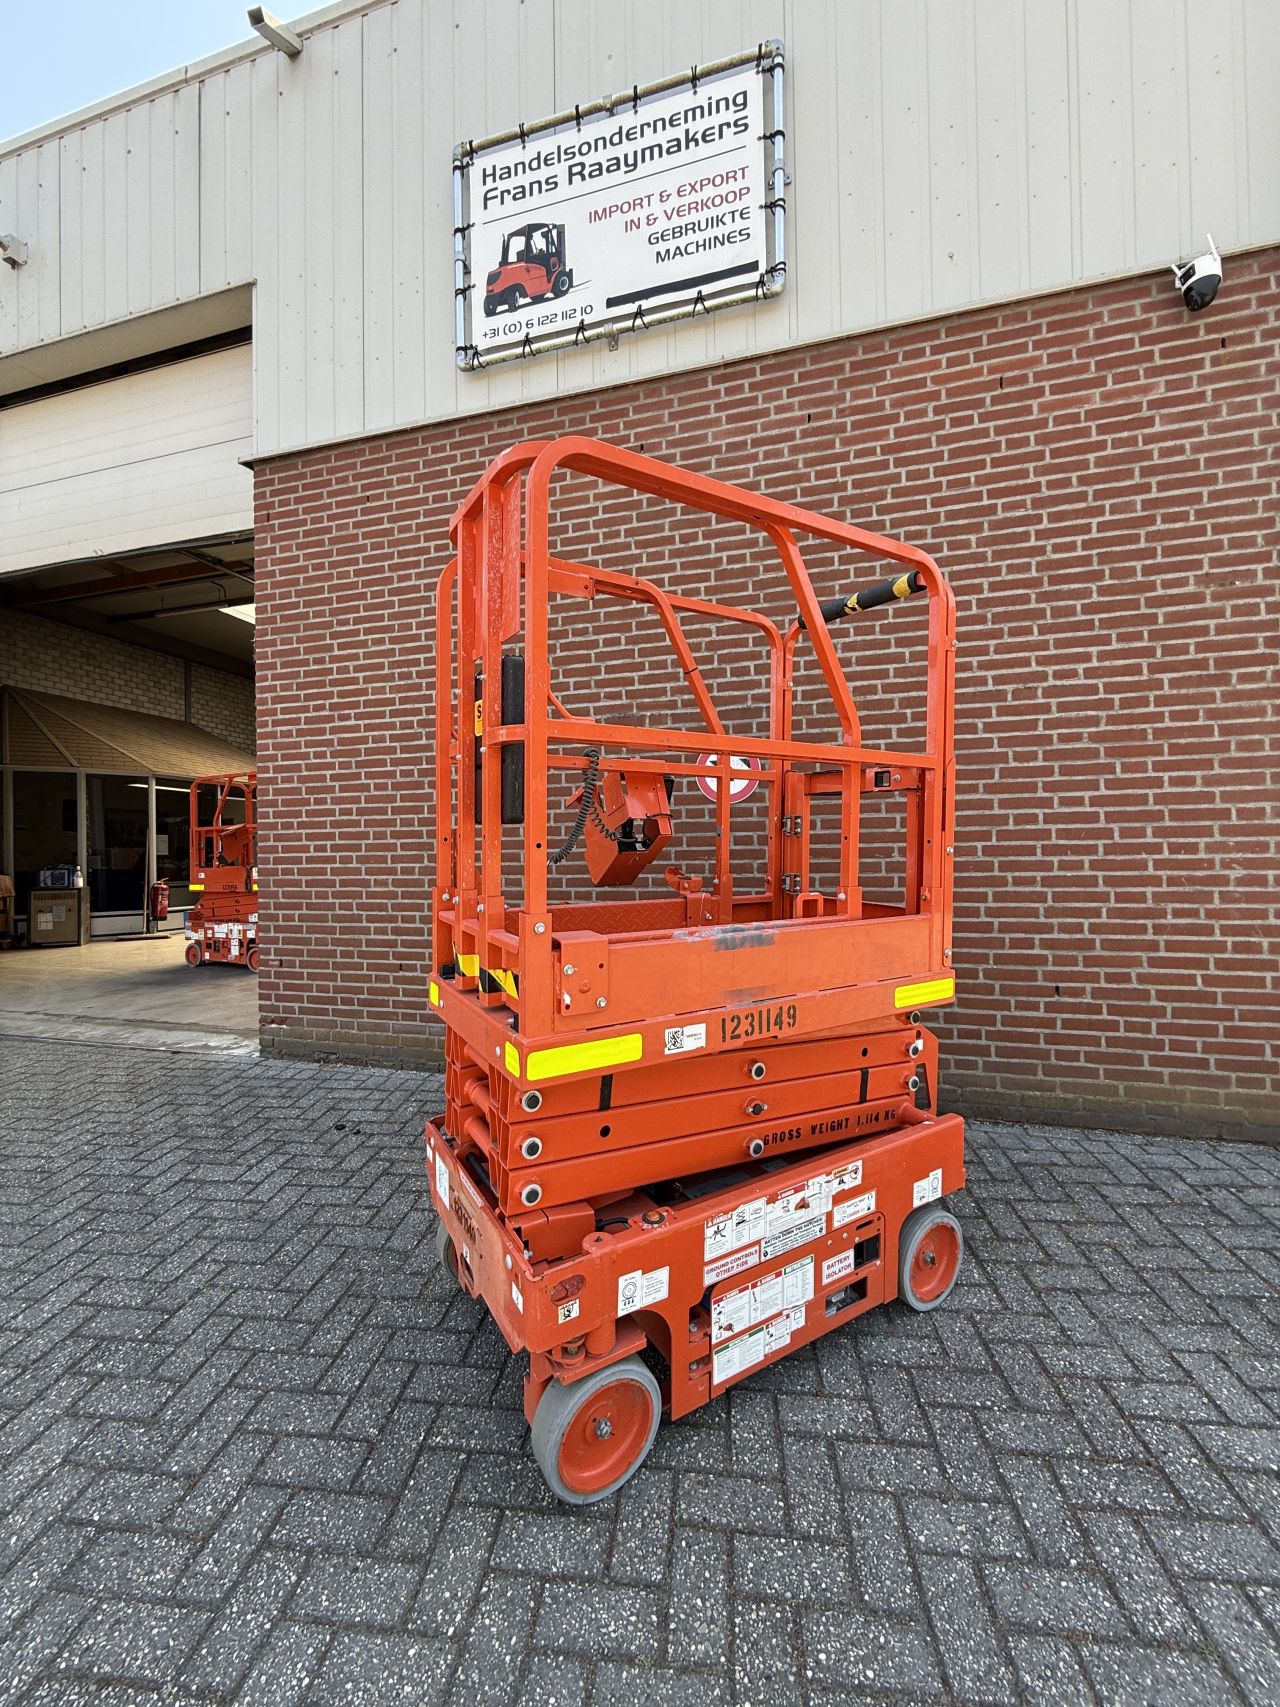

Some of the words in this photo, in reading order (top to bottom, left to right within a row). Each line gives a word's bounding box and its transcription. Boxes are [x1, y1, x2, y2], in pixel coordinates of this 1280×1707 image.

[482, 90, 748, 186] Handelsonderneming
[483, 177, 559, 210] Frans
[567, 116, 750, 185] Raaymakers
[588, 194, 653, 224] IMPORT
[659, 189, 672, 203] &
[676, 166, 749, 198] EXPORT
[624, 216, 641, 233] IN
[645, 213, 659, 227] &
[663, 187, 750, 222] VERKOOP
[647, 206, 750, 246] GEBRUIKTE
[655, 227, 751, 264] MACHINES
[482, 326, 500, 340] +31
[503, 320, 522, 336] (0)
[525, 317, 534, 330] 6
[537, 312, 558, 327] 122
[561, 307, 577, 321] 112
[580, 304, 594, 318] 10
[720, 1004, 798, 1042] 1231149
[763, 1127, 802, 1146] GROSS
[810, 1117, 849, 1136] WEIGHT
[856, 1111, 881, 1126] 1.114
[883, 1108, 897, 1121] KG
[705, 1259, 730, 1275] GROUND
[729, 1249, 758, 1266] CONTROLS
[715, 1265, 735, 1278] OTHER
[735, 1259, 749, 1271] SIDE
[825, 1263, 852, 1281] ISOLATOR
[826, 1254, 851, 1271] BATTERY
